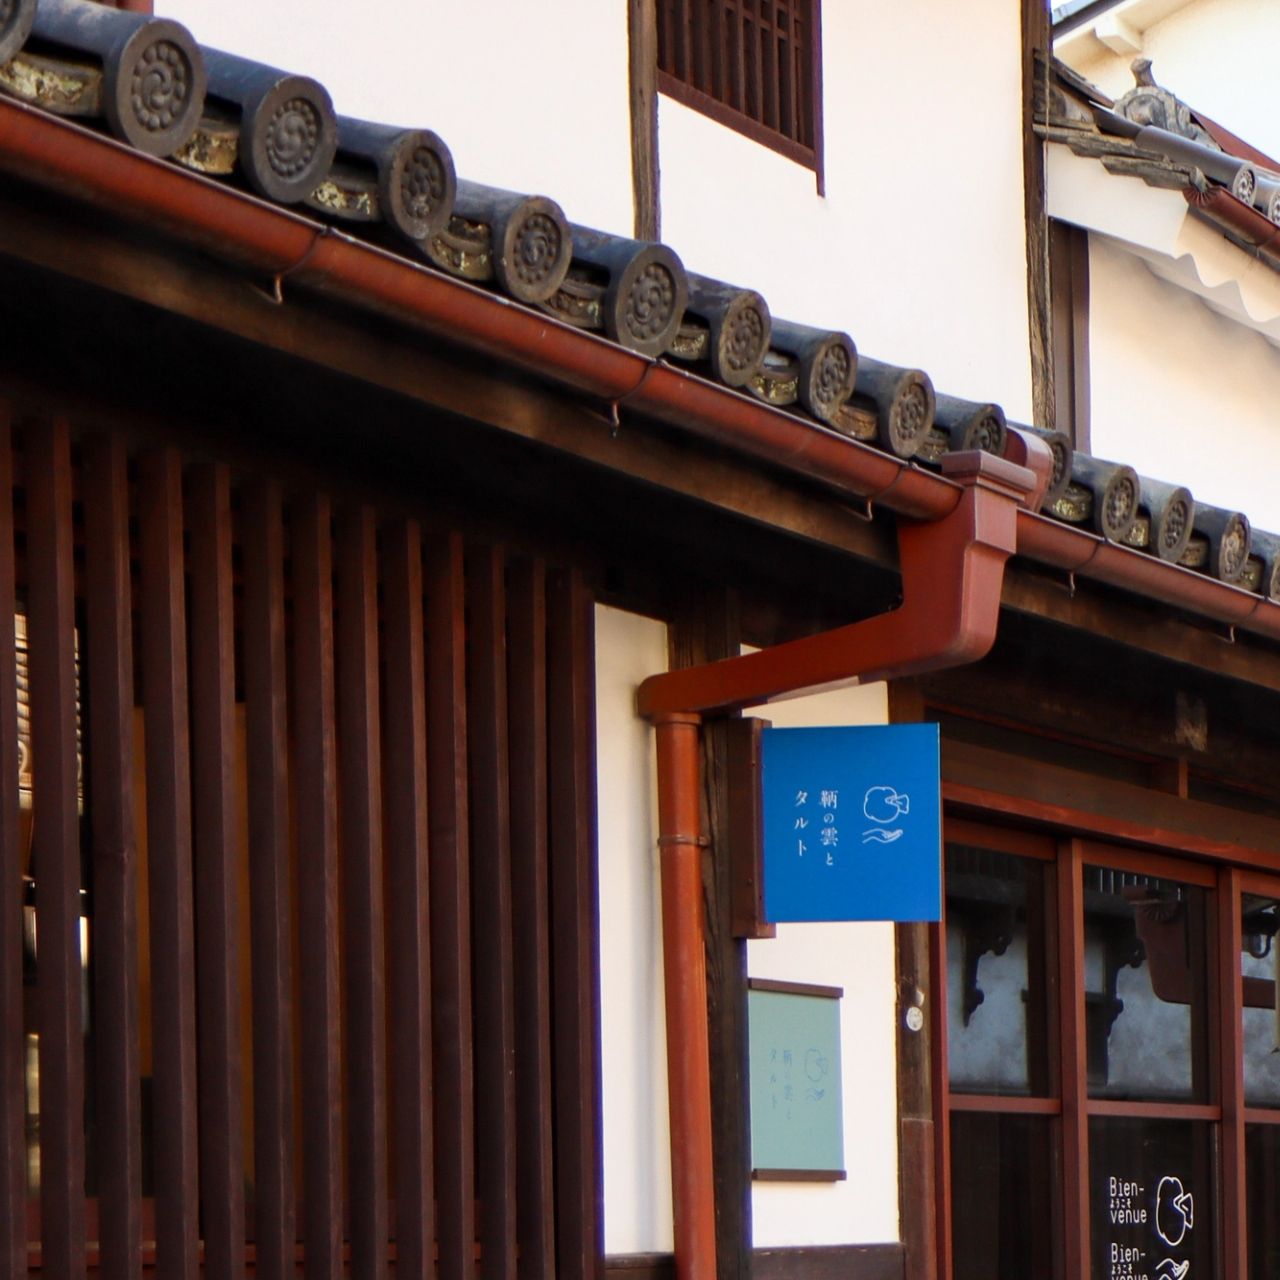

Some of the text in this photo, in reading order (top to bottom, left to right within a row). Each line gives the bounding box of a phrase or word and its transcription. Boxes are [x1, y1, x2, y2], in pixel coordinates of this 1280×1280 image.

[794, 790, 808, 857] タルト
[819, 790, 839, 866] 鞆の雲と
[1109, 1176, 1145, 1197] Bien-
[1110, 1198, 1131, 1209] ようこそ
[1110, 1208, 1147, 1224] venue
[1111, 1242, 1146, 1263] Bien-
